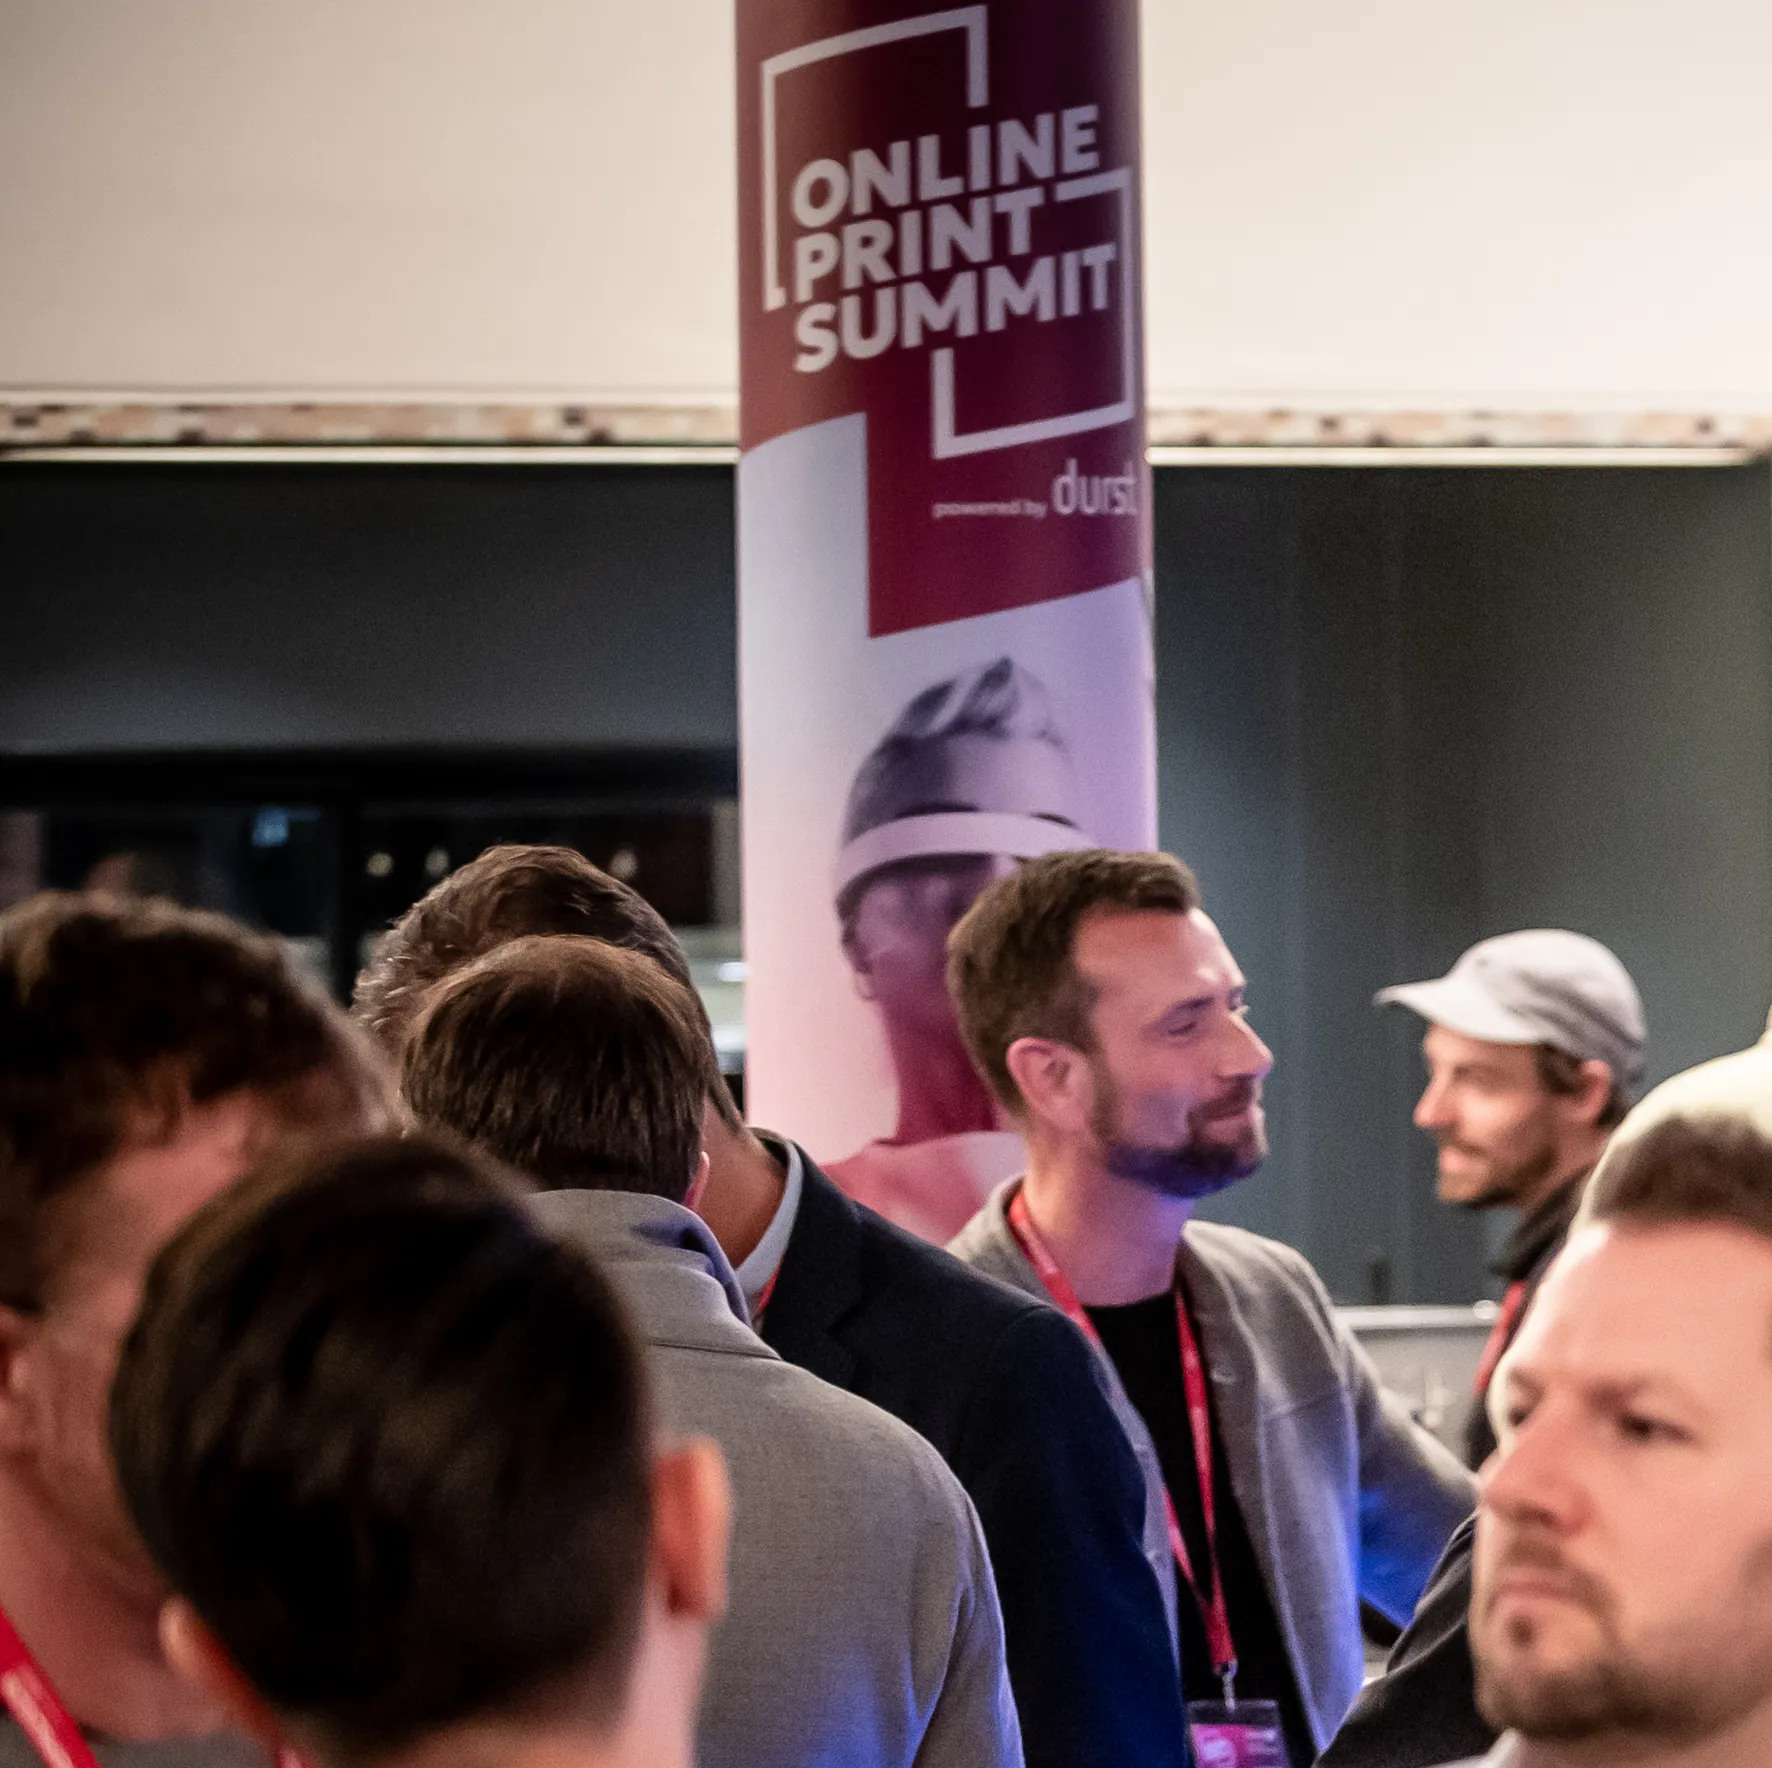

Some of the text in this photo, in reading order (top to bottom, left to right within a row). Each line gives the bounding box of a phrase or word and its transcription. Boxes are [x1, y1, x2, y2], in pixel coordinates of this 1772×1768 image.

[790, 103, 1100, 229] ONLINE
[793, 185, 1046, 302] PRINT
[792, 242, 1118, 375] SUMMIT
[1052, 457, 1138, 516] durst
